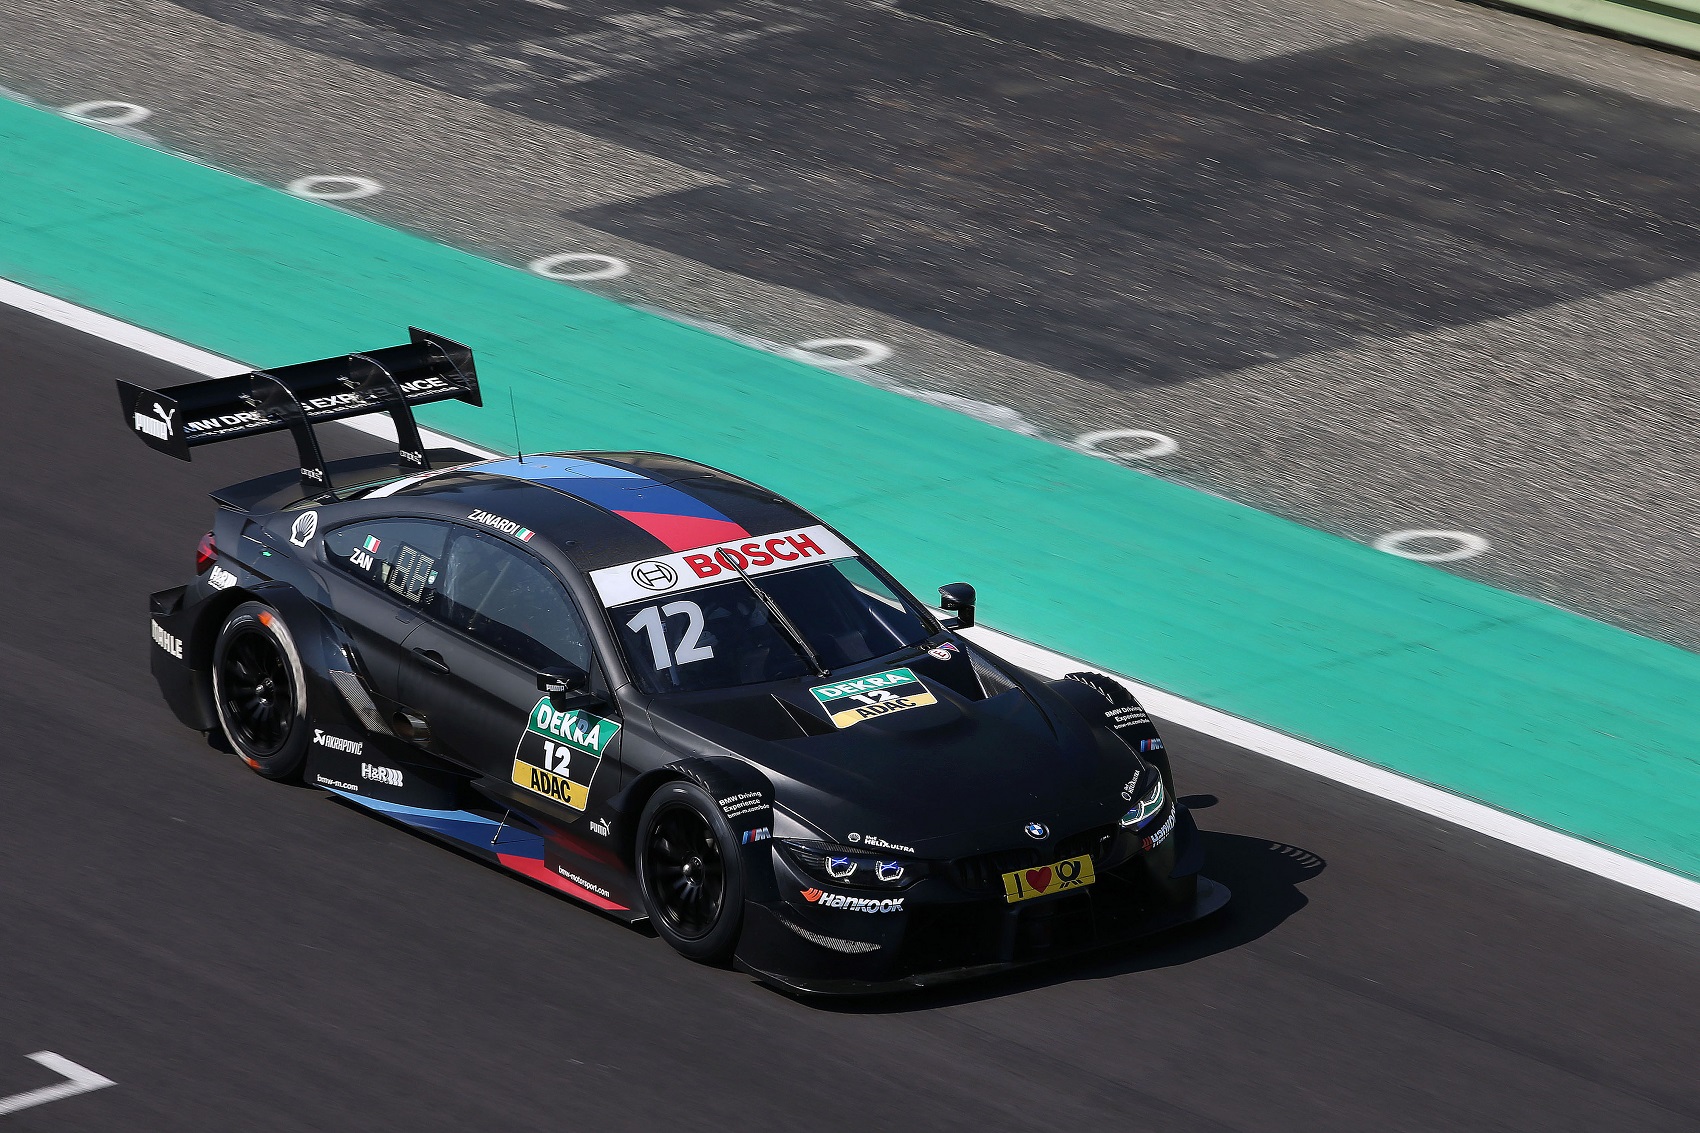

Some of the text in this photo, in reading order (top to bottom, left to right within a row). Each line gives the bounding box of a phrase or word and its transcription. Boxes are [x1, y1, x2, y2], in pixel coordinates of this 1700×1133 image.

[467, 508, 520, 536] ZANARDI
[349, 547, 374, 572] ZAN
[682, 533, 827, 579] BOSCH
[626, 600, 715, 671] 12
[820, 674, 911, 698] DEKRA
[849, 690, 900, 705] 12
[855, 698, 917, 719] ADAC
[537, 703, 600, 751] DEKRA
[544, 740, 571, 779] 12
[316, 773, 359, 792] bmw-m.com
[530, 767, 572, 804] ADAC
[719, 791, 763, 807] BMW Driving
[723, 798, 761, 813] Experience
[590, 820, 608, 838] PUMA
[864, 838, 915, 854] HELIX ULTRA
[558, 865, 610, 898] bmw-motorsport.com
